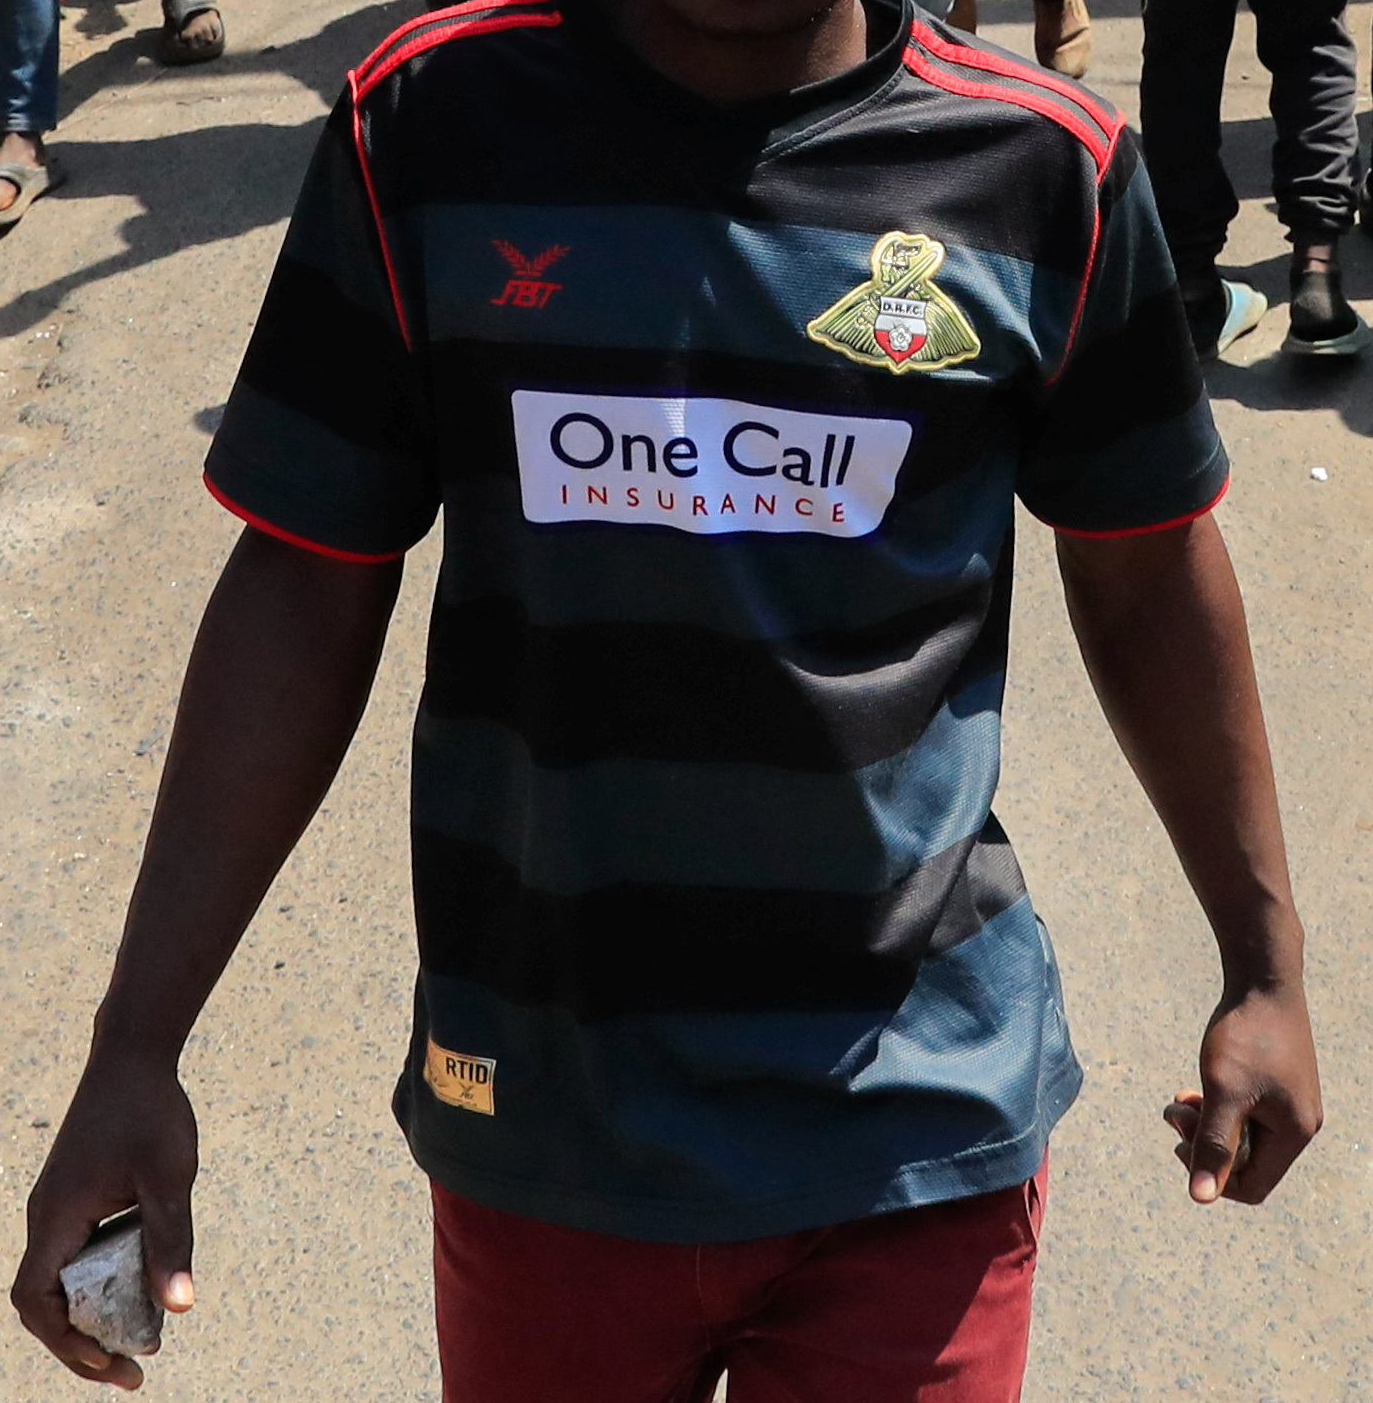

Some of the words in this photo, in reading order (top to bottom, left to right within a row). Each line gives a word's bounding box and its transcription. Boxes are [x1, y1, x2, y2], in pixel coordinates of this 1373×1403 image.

[490, 280, 564, 308] FBT
[550, 413, 699, 478] One
[723, 421, 856, 488] Call
[561, 485, 845, 523] INSURANCE
[446, 1057, 488, 1085] RTID
